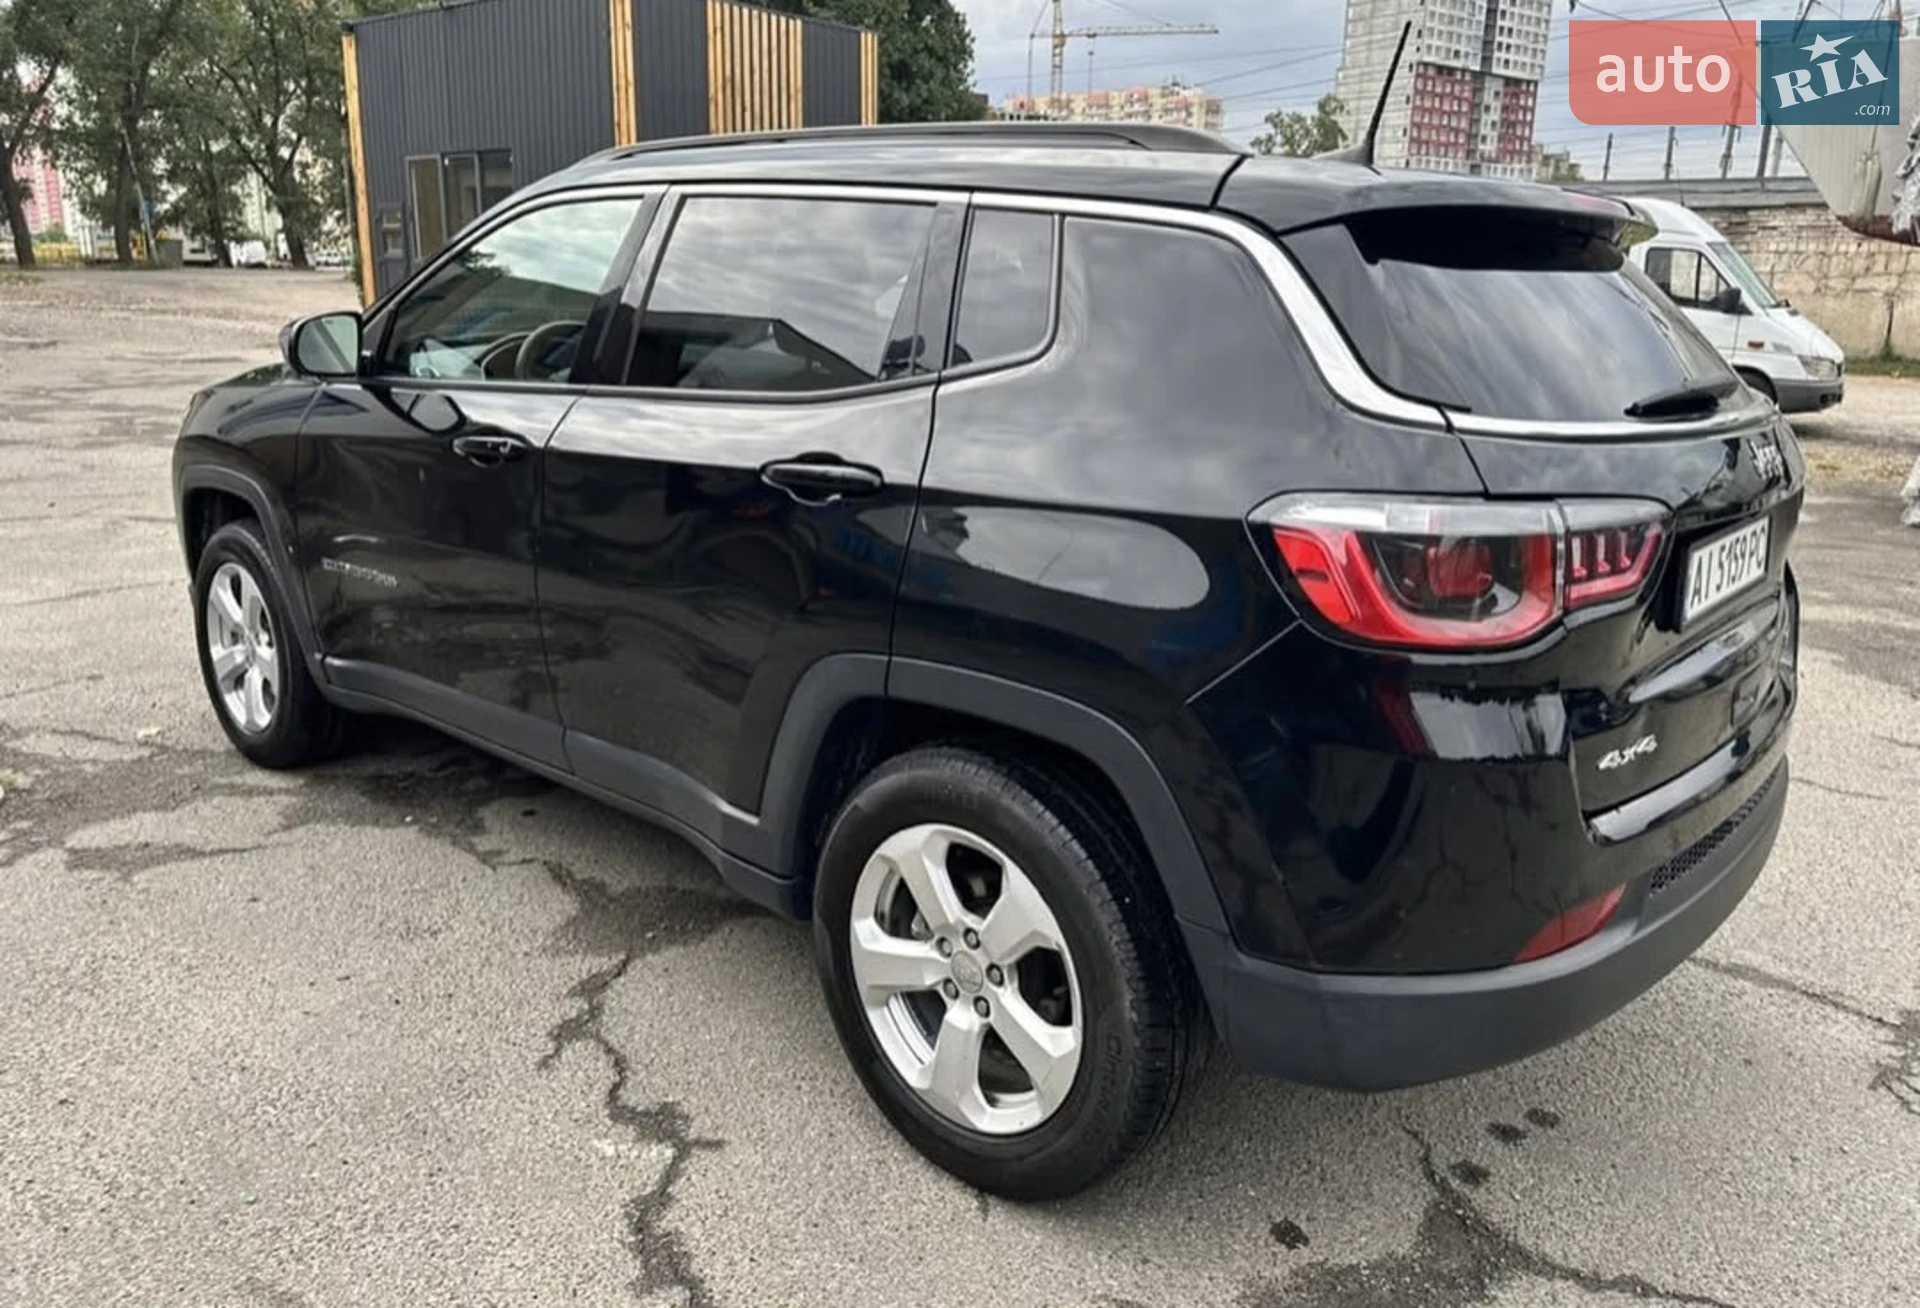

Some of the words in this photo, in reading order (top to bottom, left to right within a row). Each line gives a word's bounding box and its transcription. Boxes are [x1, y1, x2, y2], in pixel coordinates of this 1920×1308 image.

[1690, 549, 1713, 609] AI
[1715, 534, 1748, 594] 5159
[1746, 524, 1766, 577] PC
